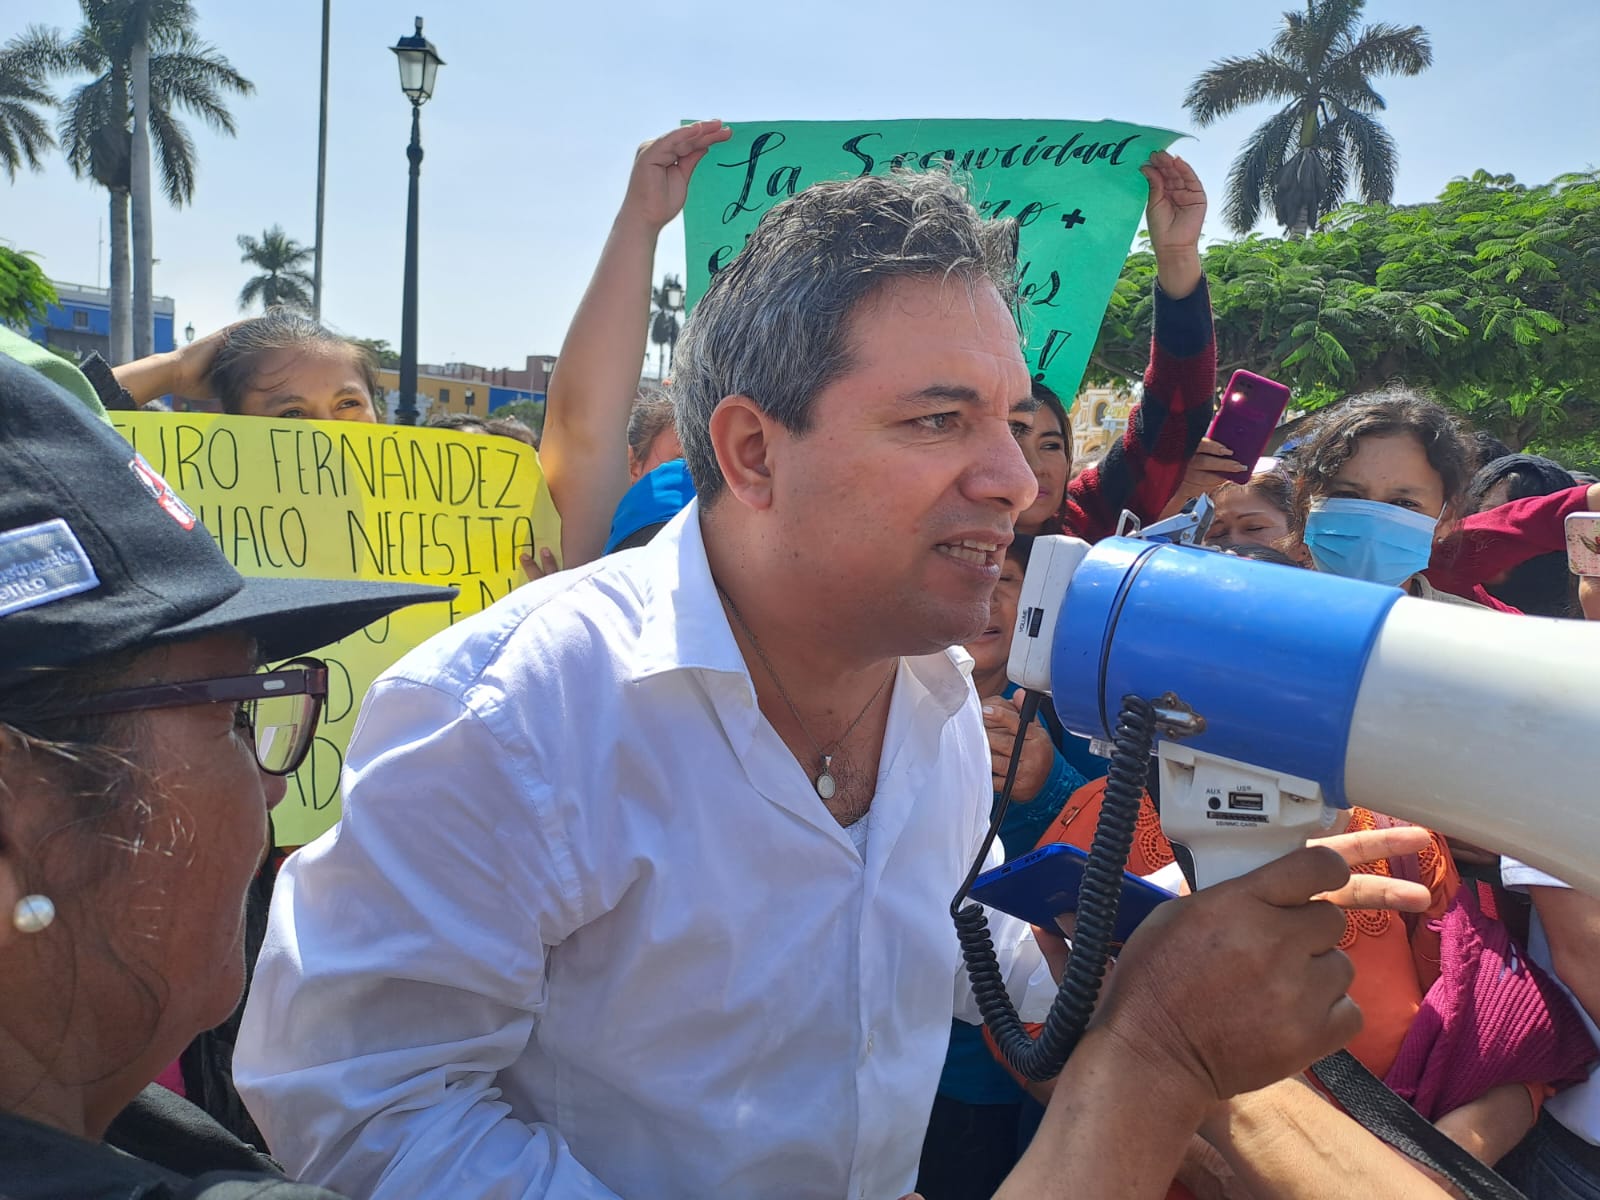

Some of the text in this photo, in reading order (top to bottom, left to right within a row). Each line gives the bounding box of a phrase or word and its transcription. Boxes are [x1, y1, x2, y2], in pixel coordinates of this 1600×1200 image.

[717, 131, 802, 224] La
[114, 424, 520, 508] URO FERNÁNDEZ
[347, 510, 535, 576] NECESITA
